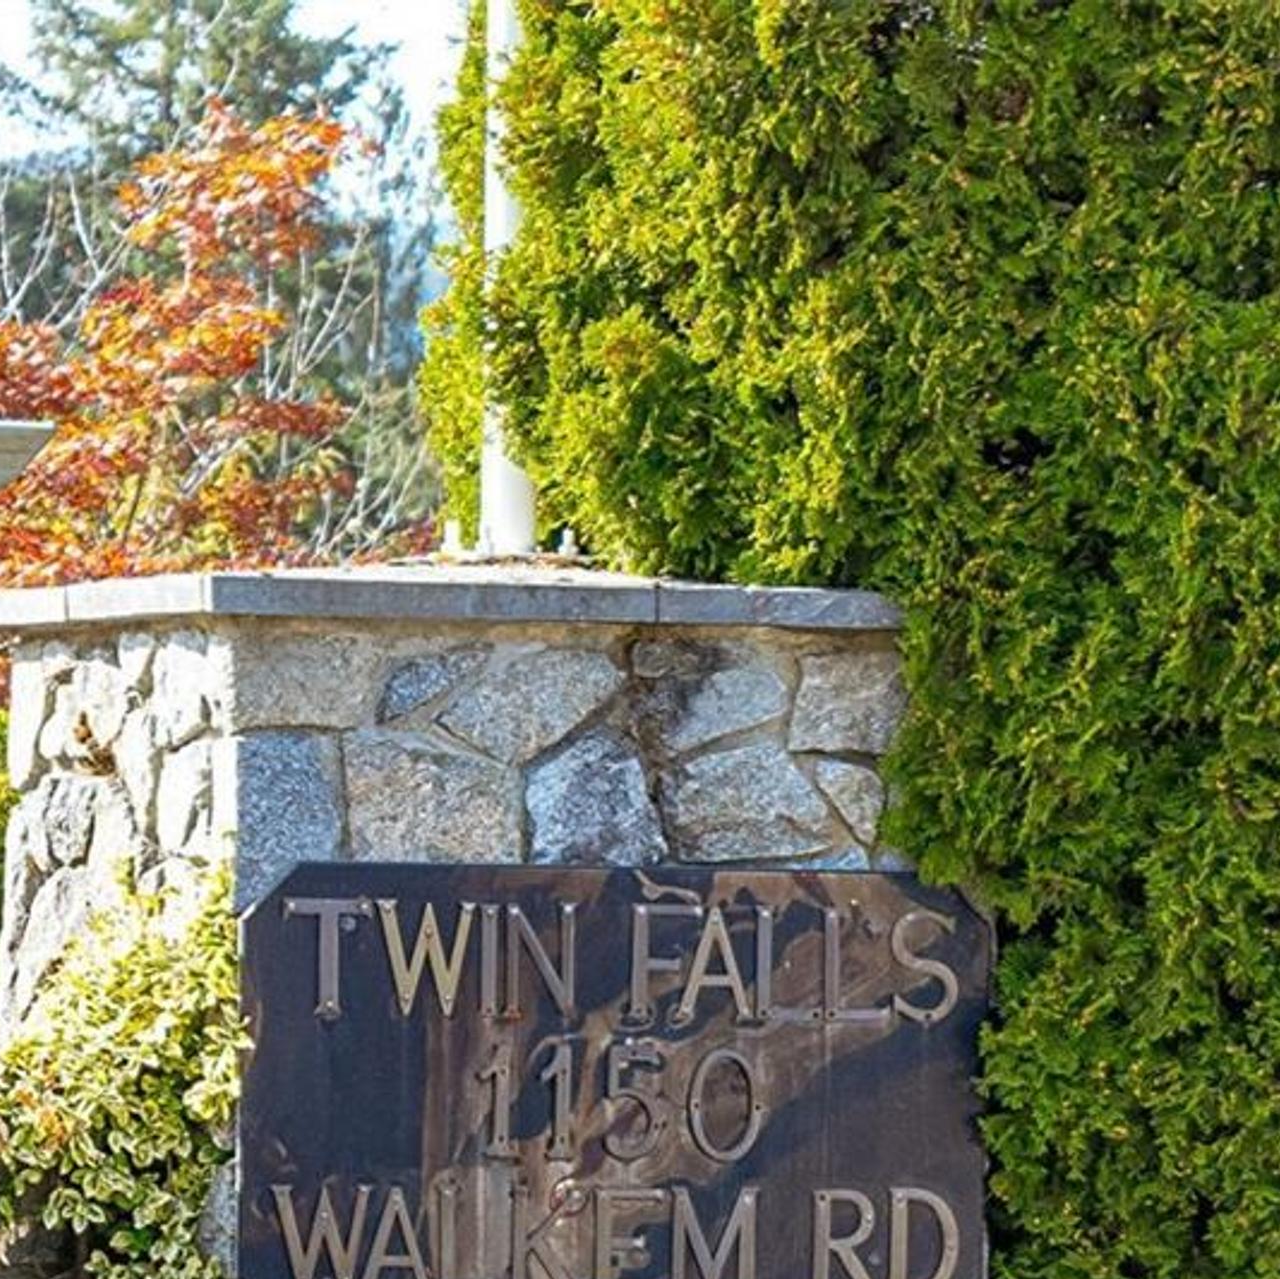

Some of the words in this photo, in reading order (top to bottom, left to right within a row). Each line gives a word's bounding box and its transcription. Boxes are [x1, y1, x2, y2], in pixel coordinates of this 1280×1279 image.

[283, 899, 577, 1020] TWIN
[622, 901, 961, 1027] FALLS
[477, 1042, 765, 1164] 1150
